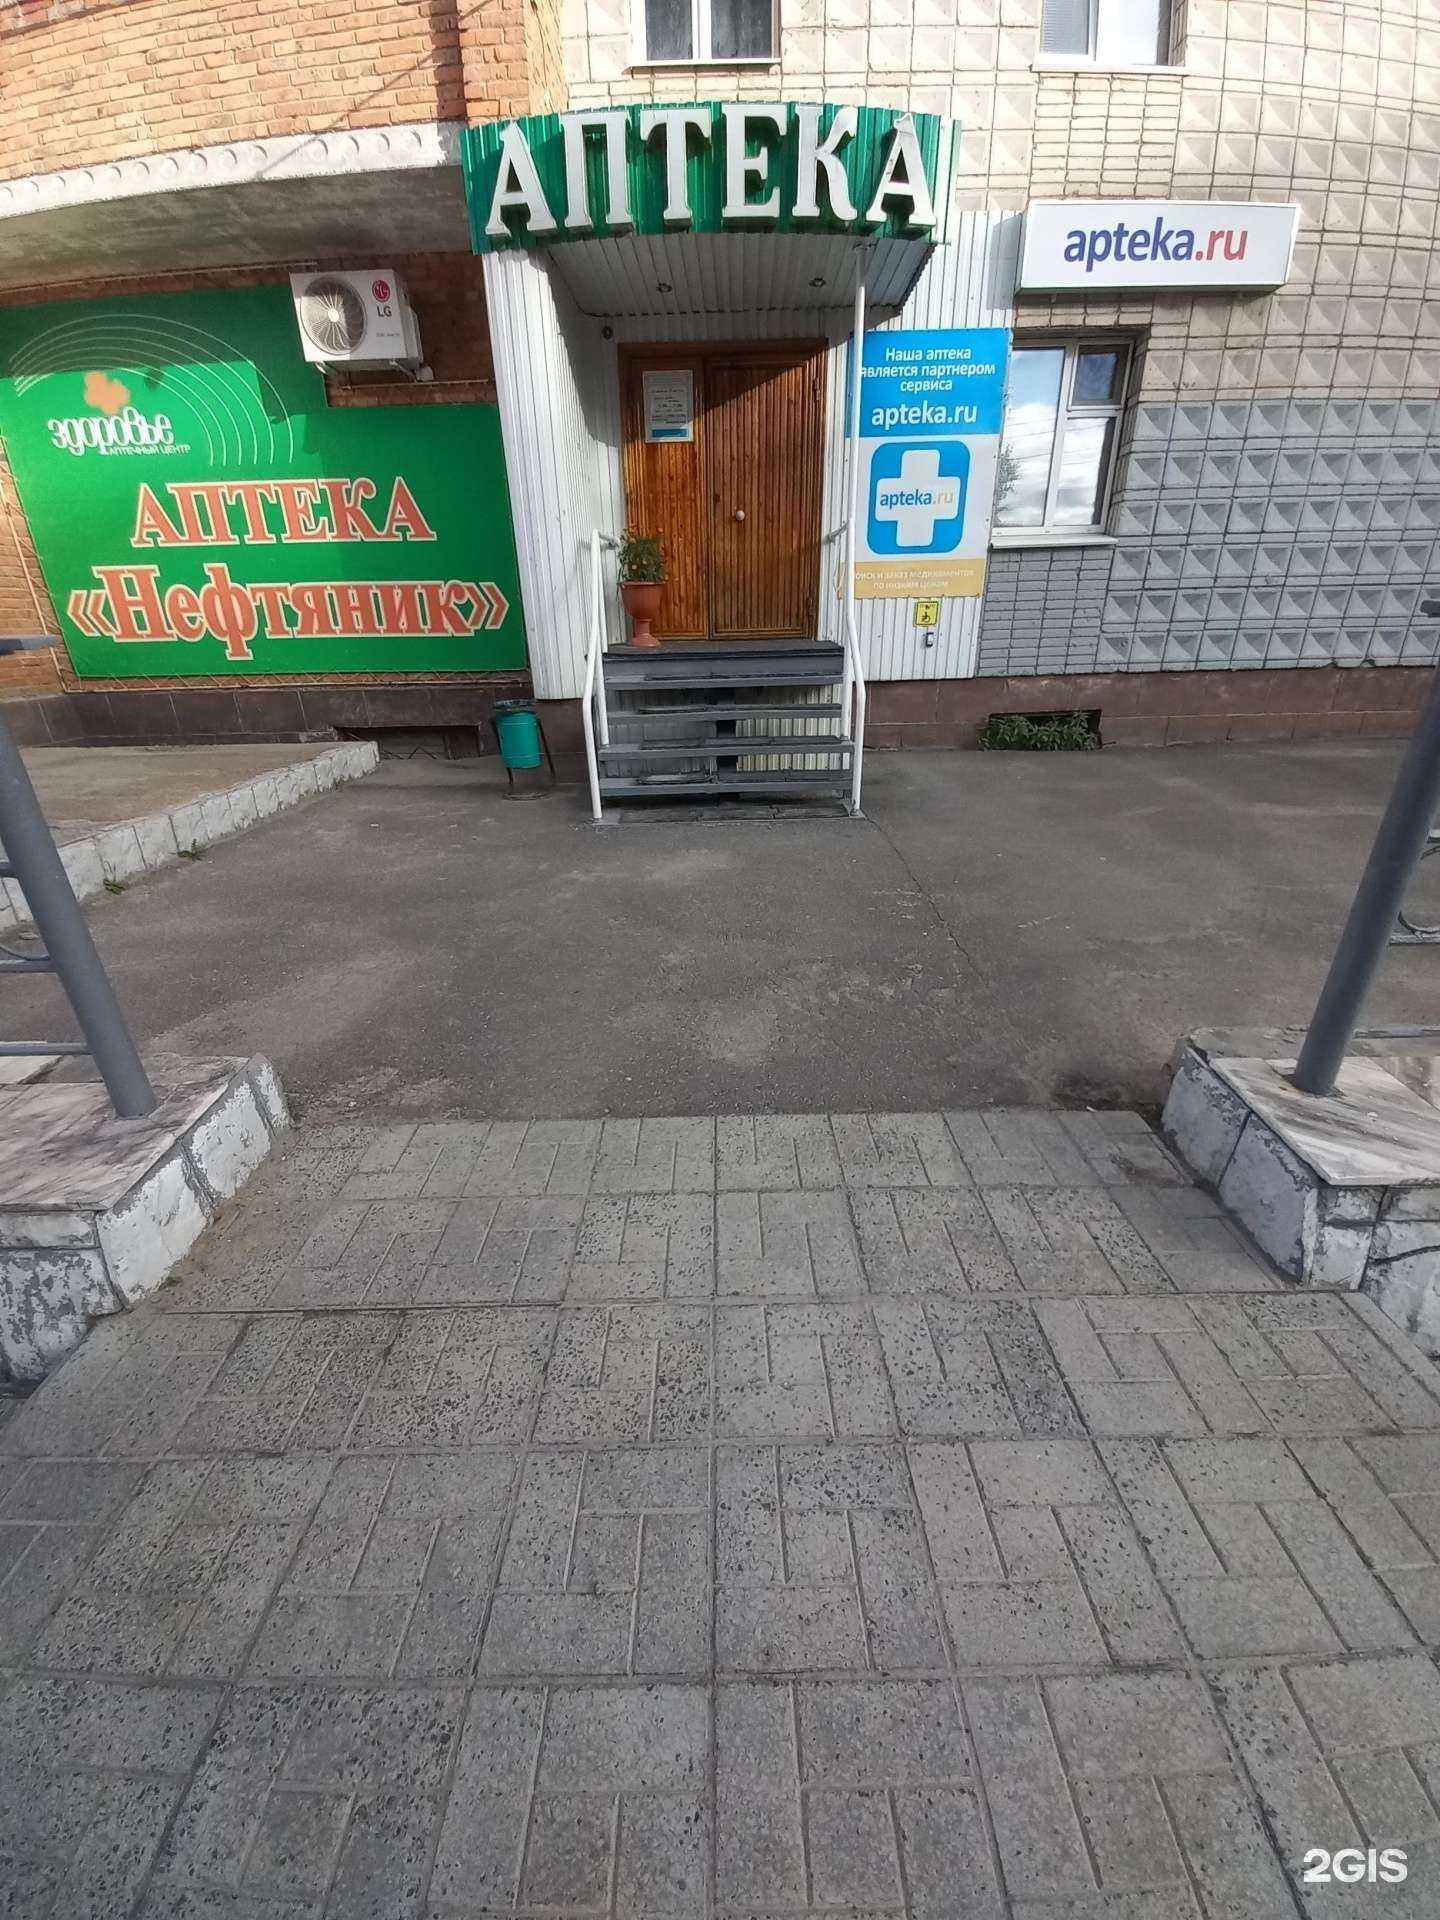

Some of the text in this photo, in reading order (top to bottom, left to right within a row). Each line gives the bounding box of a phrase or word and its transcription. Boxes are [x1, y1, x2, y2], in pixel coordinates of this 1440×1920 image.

[485, 104, 937, 235] АПТЕКА
[1064, 217, 1248, 273] apteka.ru
[377, 306, 392, 317] LG
[885, 347, 972, 362] Наша аптека
[921, 363, 996, 379] партнером
[900, 379, 953, 394] сервиса
[871, 400, 978, 431] apteka.ru
[130, 476, 437, 547] АПТЕКА
[880, 489, 955, 509] apteka.ru
[67, 562, 510, 661] «Нефтяник»
